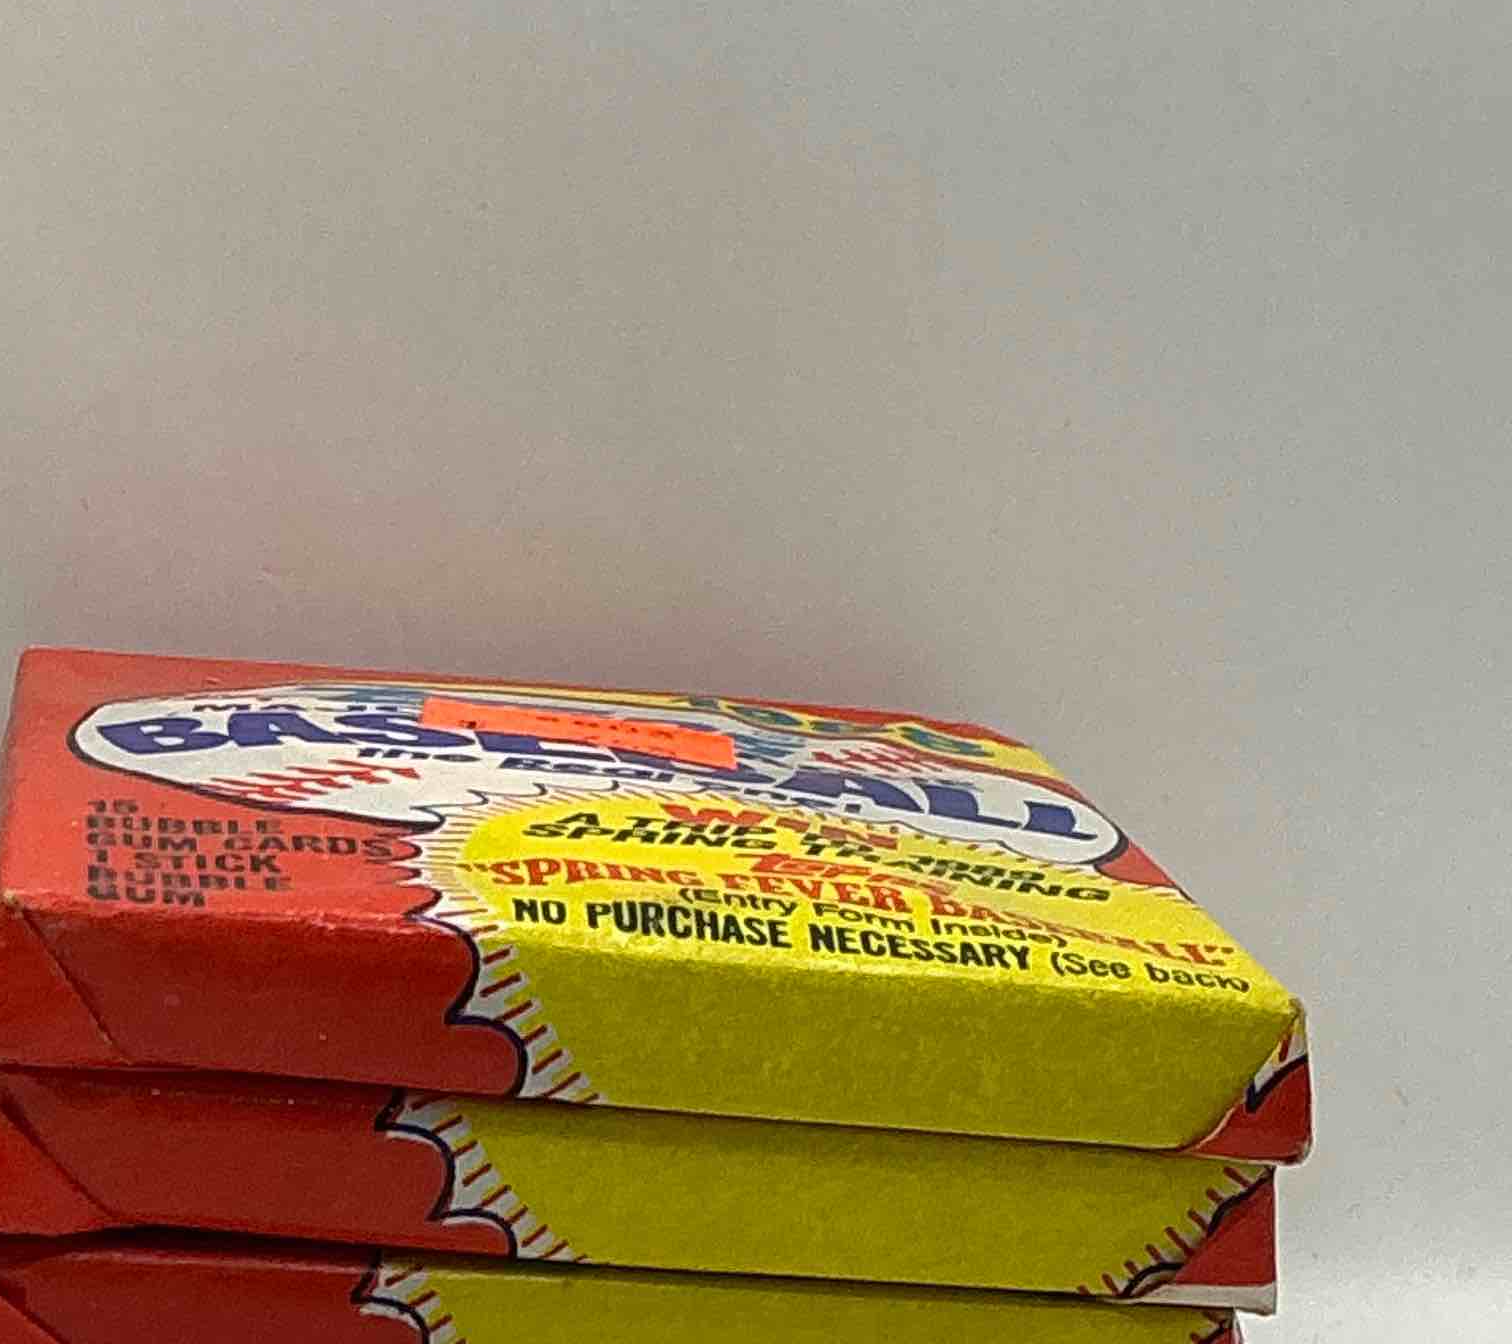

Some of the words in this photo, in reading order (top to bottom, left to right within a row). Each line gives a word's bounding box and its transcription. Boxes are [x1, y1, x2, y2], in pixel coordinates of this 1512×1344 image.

[512, 896, 568, 926] NO
[586, 900, 794, 950] PURCHASE
[809, 922, 1032, 971] NECESSARY
[1049, 951, 1133, 979] (See
